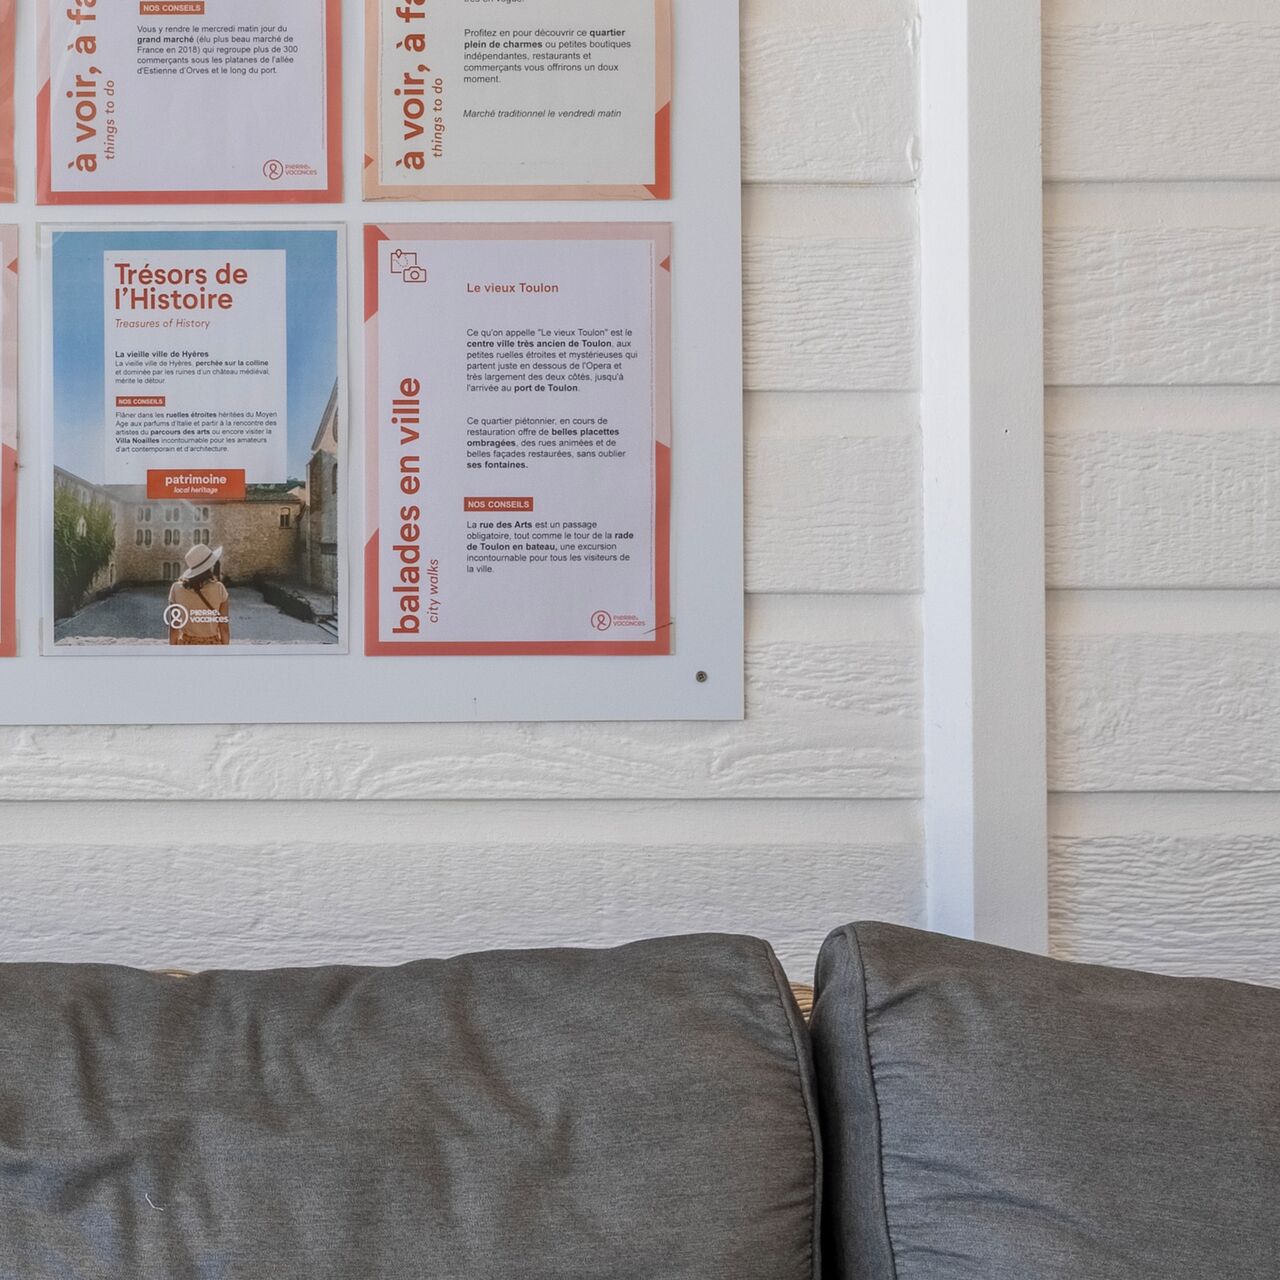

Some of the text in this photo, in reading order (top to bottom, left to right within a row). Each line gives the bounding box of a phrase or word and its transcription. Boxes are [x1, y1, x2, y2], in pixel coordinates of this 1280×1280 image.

[143, 4, 201, 12] NOS CONSEILS
[67, 36, 97, 54] à
[396, 33, 425, 52] à
[66, 66, 102, 142] voir,
[394, 64, 430, 140] voir,
[104, 80, 117, 160] things to do
[431, 78, 446, 158] things to do
[66, 153, 97, 172] à
[396, 151, 425, 170] à
[115, 263, 248, 285] Trésors de
[467, 283, 558, 292] Le vieux Toulon
[115, 288, 233, 310] l'Histoire
[116, 319, 210, 329] Treasures of History
[182, 351, 208, 359] Hyères
[166, 474, 227, 486] patrimoine
[173, 486, 218, 495] local heritage
[391, 377, 420, 633] balades en ville
[487, 501, 530, 509] CONSEILS
[427, 559, 441, 623] city walks
